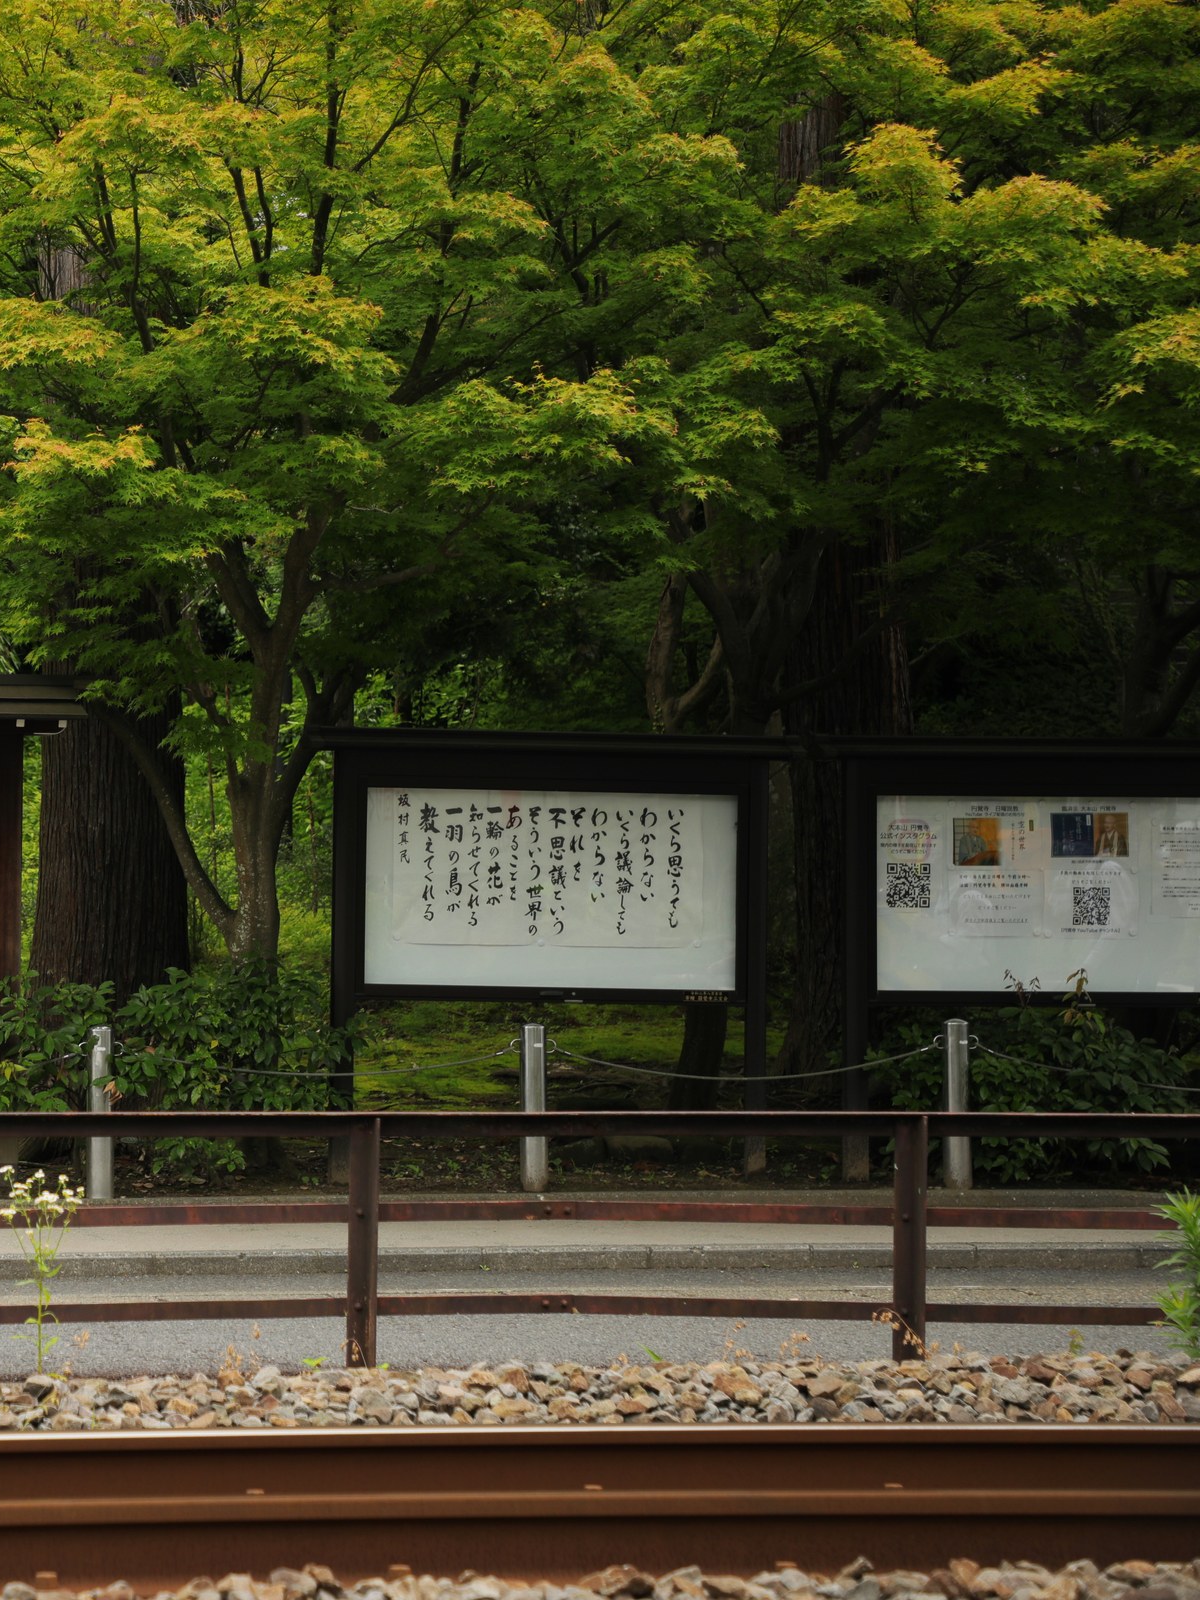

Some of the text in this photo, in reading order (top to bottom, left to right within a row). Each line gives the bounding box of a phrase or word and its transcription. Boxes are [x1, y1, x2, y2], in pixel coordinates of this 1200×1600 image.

[396, 790, 410, 866] 坂村真民
[416, 800, 440, 924] 教えてくれる
[442, 804, 462, 915] 一羽の鳥が
[464, 801, 482, 929] 知らせてくれる
[483, 804, 503, 908] 一輪の花が
[503, 802, 522, 902] あることを
[522, 804, 544, 939] そういう世界の
[546, 806, 565, 938] 不思議という
[568, 804, 586, 882] それを
[588, 806, 607, 904] わからない
[638, 806, 657, 903] わからない
[880, 832, 936, 840] 公式インスタグラム
